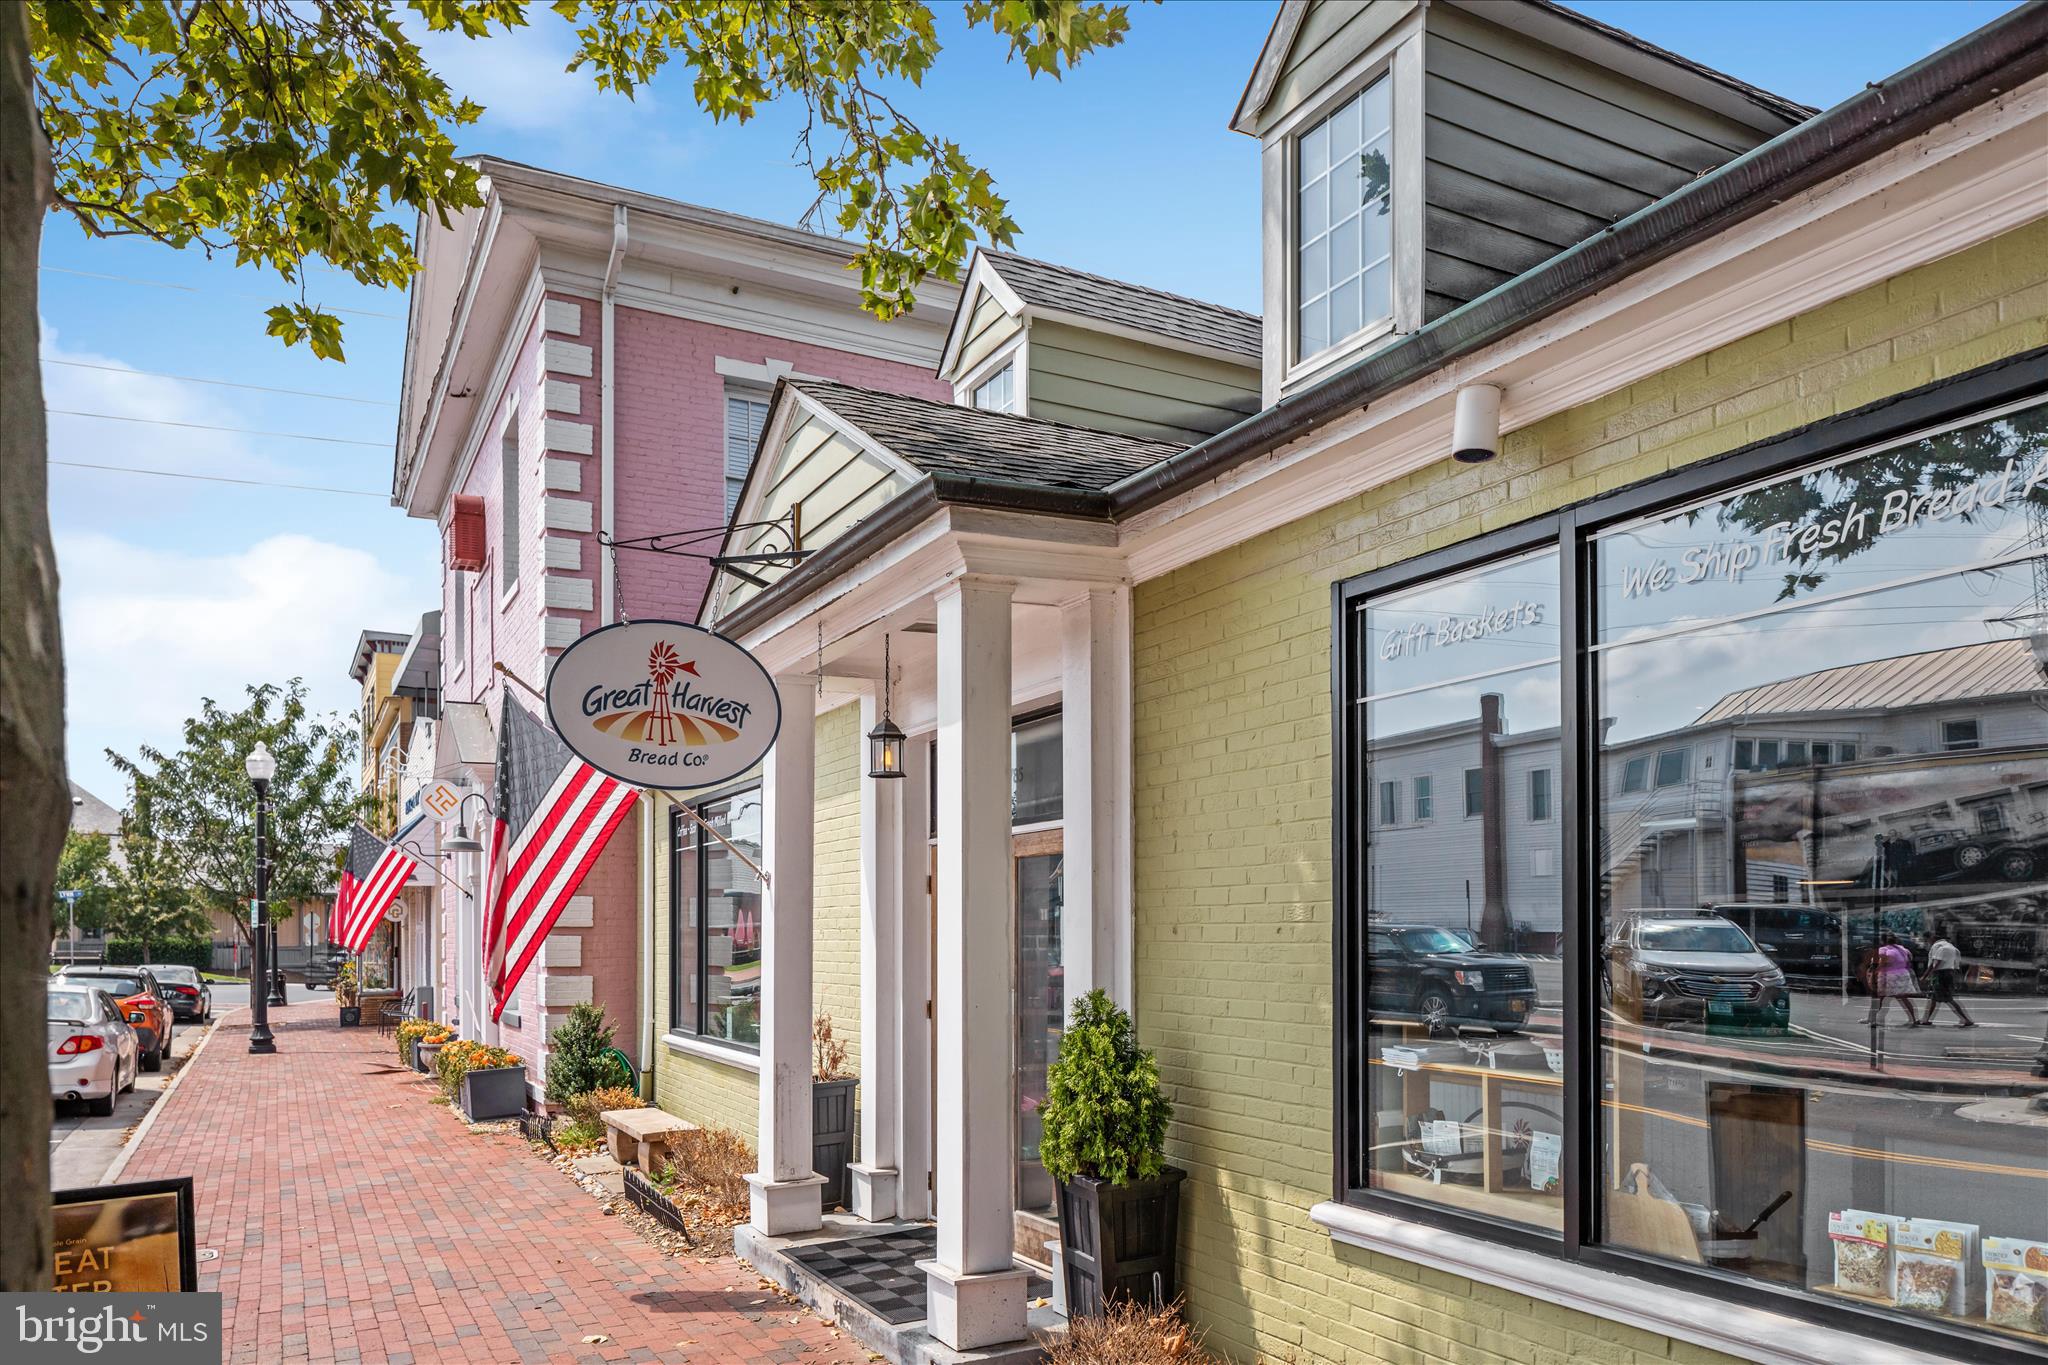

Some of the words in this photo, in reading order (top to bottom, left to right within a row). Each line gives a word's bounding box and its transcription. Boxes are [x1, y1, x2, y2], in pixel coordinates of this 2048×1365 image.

[1622, 559, 1668, 600] We
[1679, 538, 1752, 584] Ship
[1763, 502, 1866, 565] Fresh
[1879, 458, 2015, 534] Bread
[1379, 622, 1427, 661] Gift
[1435, 599, 1538, 647] Baskets
[582, 679, 653, 717] Great
[672, 681, 752, 729] Harvest
[628, 748, 678, 767] Bread
[54, 1246, 115, 1276] EAT
[65, 1238, 88, 1246] Grain
